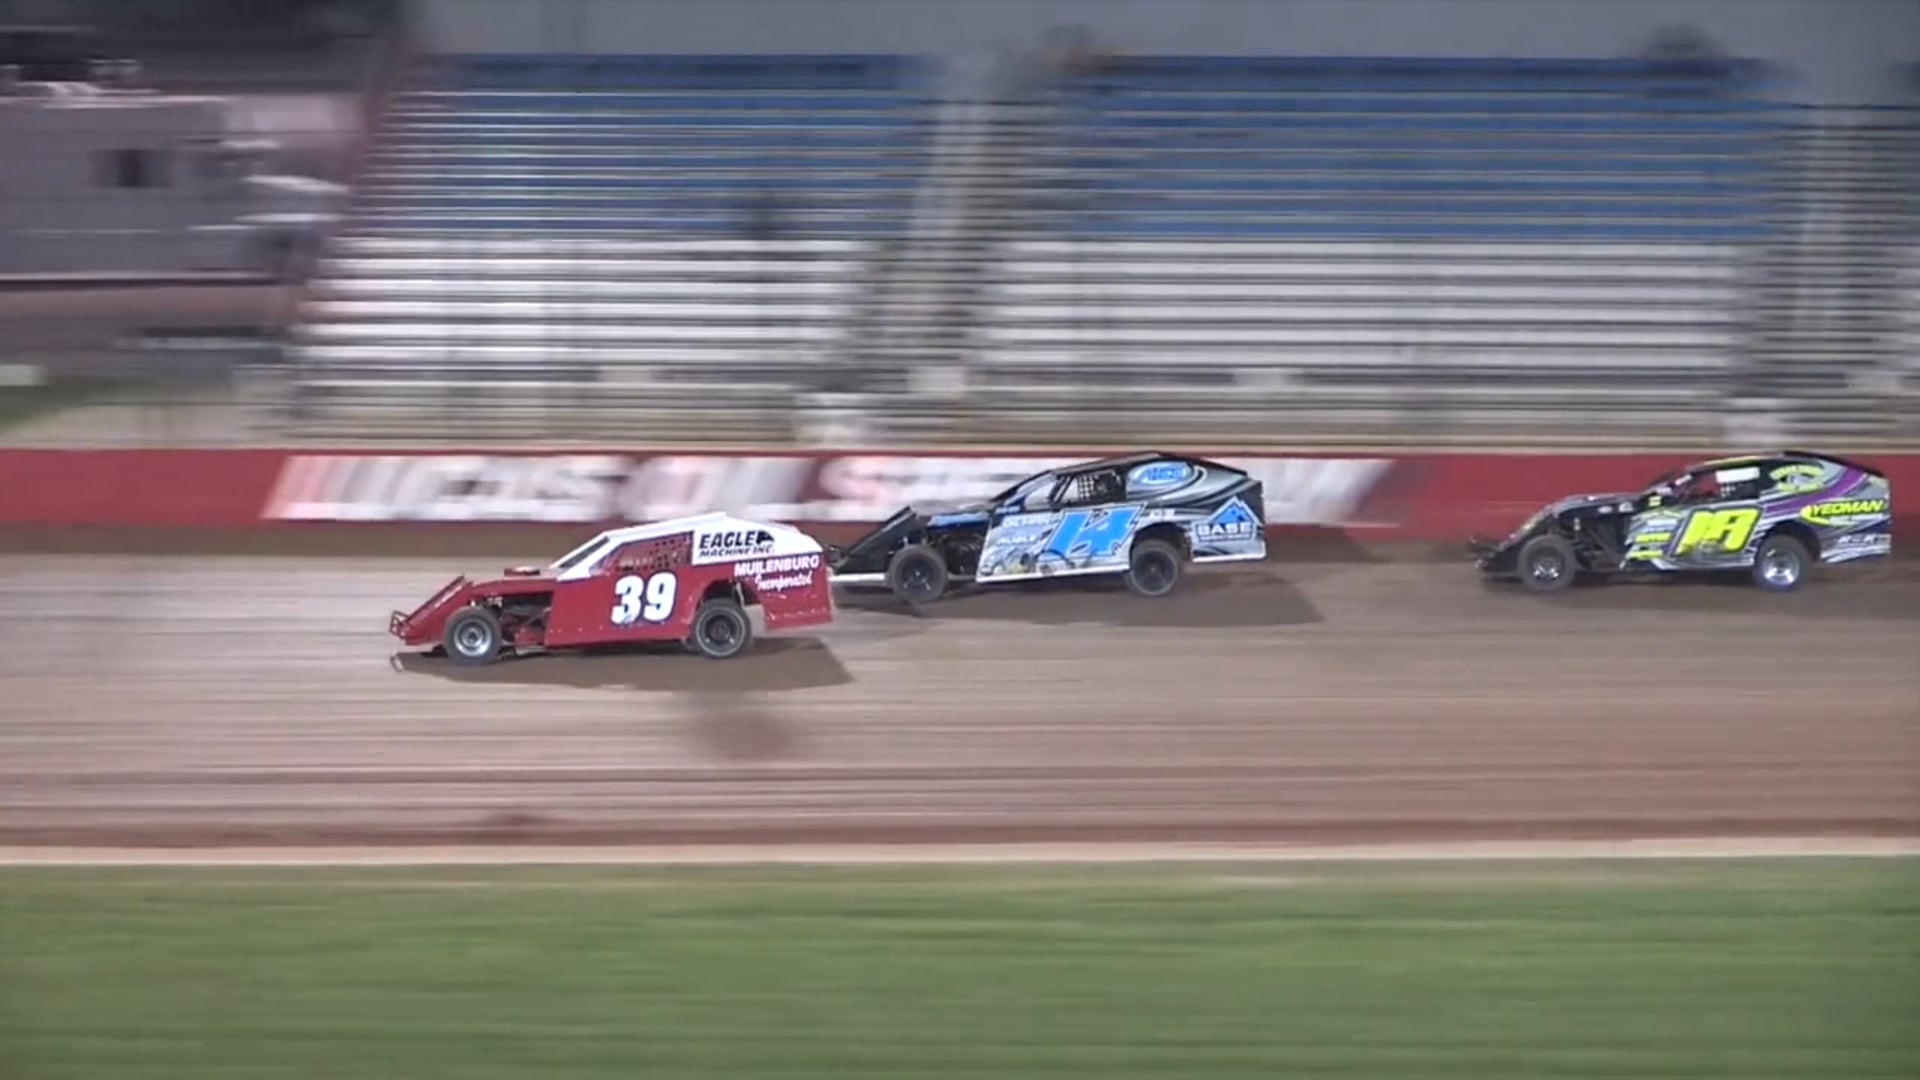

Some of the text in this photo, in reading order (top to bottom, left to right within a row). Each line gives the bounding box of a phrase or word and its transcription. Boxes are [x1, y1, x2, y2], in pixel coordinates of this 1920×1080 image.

[1811, 500, 1884, 517] YEOMAN
[1043, 505, 1143, 557] 14
[1197, 523, 1251, 536] BASE
[699, 531, 757, 549] EAGLE
[699, 548, 749, 557] MACHINE
[610, 571, 677, 624] 39
